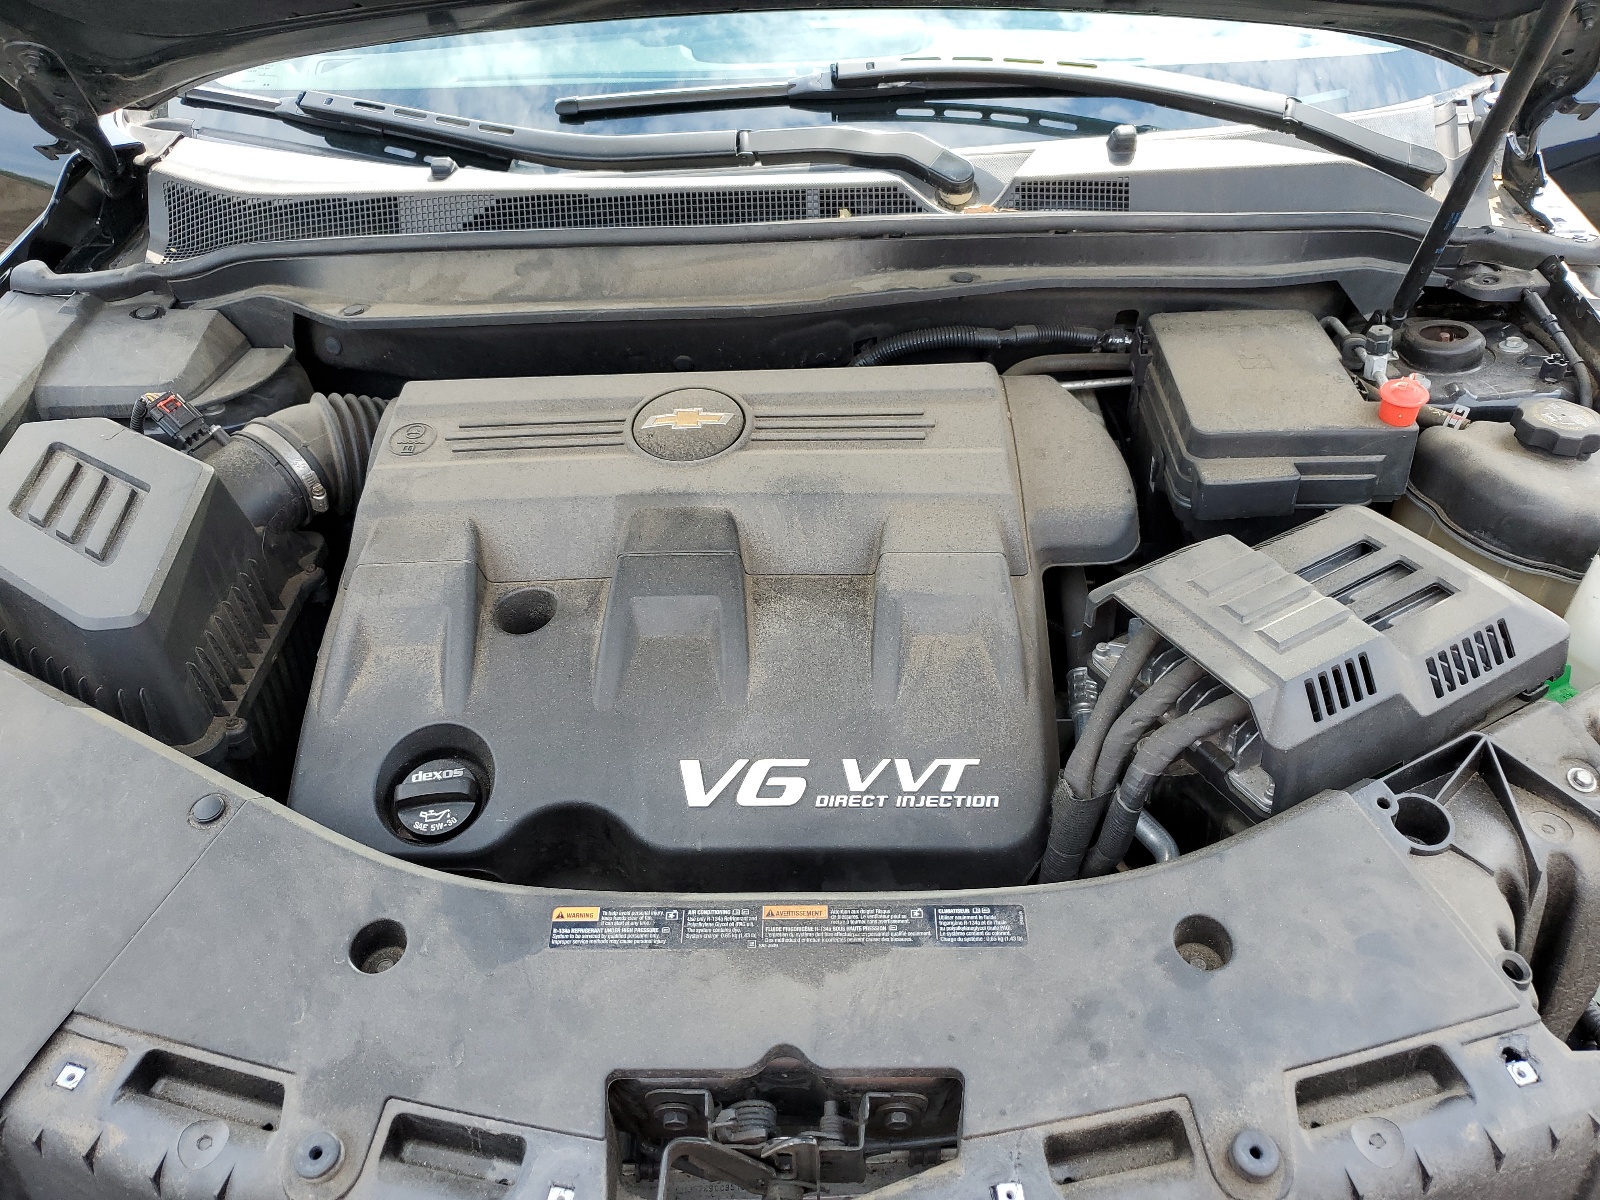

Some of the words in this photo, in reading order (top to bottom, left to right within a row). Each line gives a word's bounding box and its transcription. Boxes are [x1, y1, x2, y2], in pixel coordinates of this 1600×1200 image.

[411, 767, 466, 783] dexos
[679, 759, 810, 807] V6
[842, 758, 981, 792] VVT
[815, 795, 889, 808] DIRECT
[895, 795, 1000, 808] INJECTION
[413, 821, 429, 832] SAE
[430, 816, 458, 832] 5W-30
